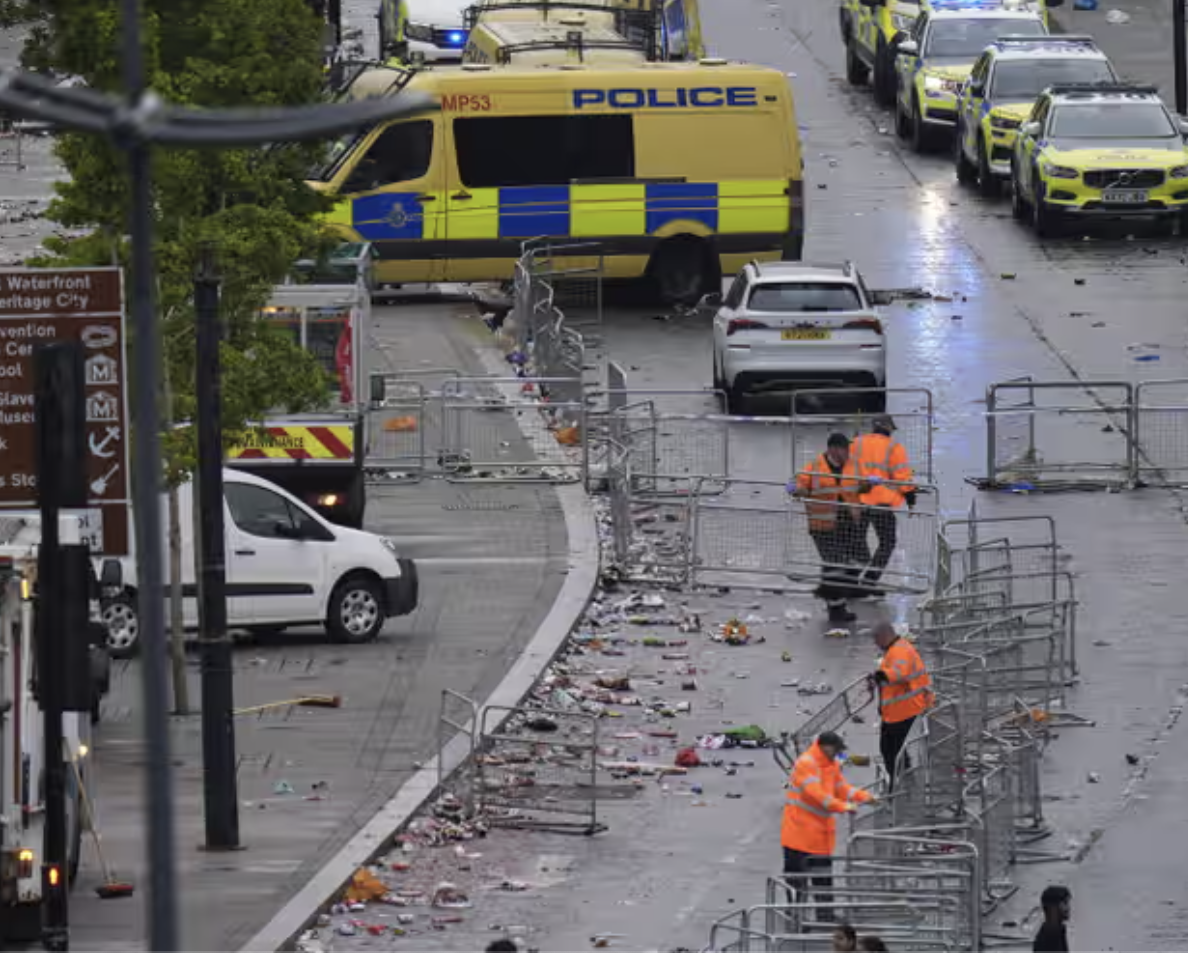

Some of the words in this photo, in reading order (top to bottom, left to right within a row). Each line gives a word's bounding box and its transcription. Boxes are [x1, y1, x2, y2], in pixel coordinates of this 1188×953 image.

[441, 94, 491, 111] MP53
[572, 87, 758, 108] POLICE
[7, 275, 91, 291] Waterfront
[56, 293, 89, 310] City
